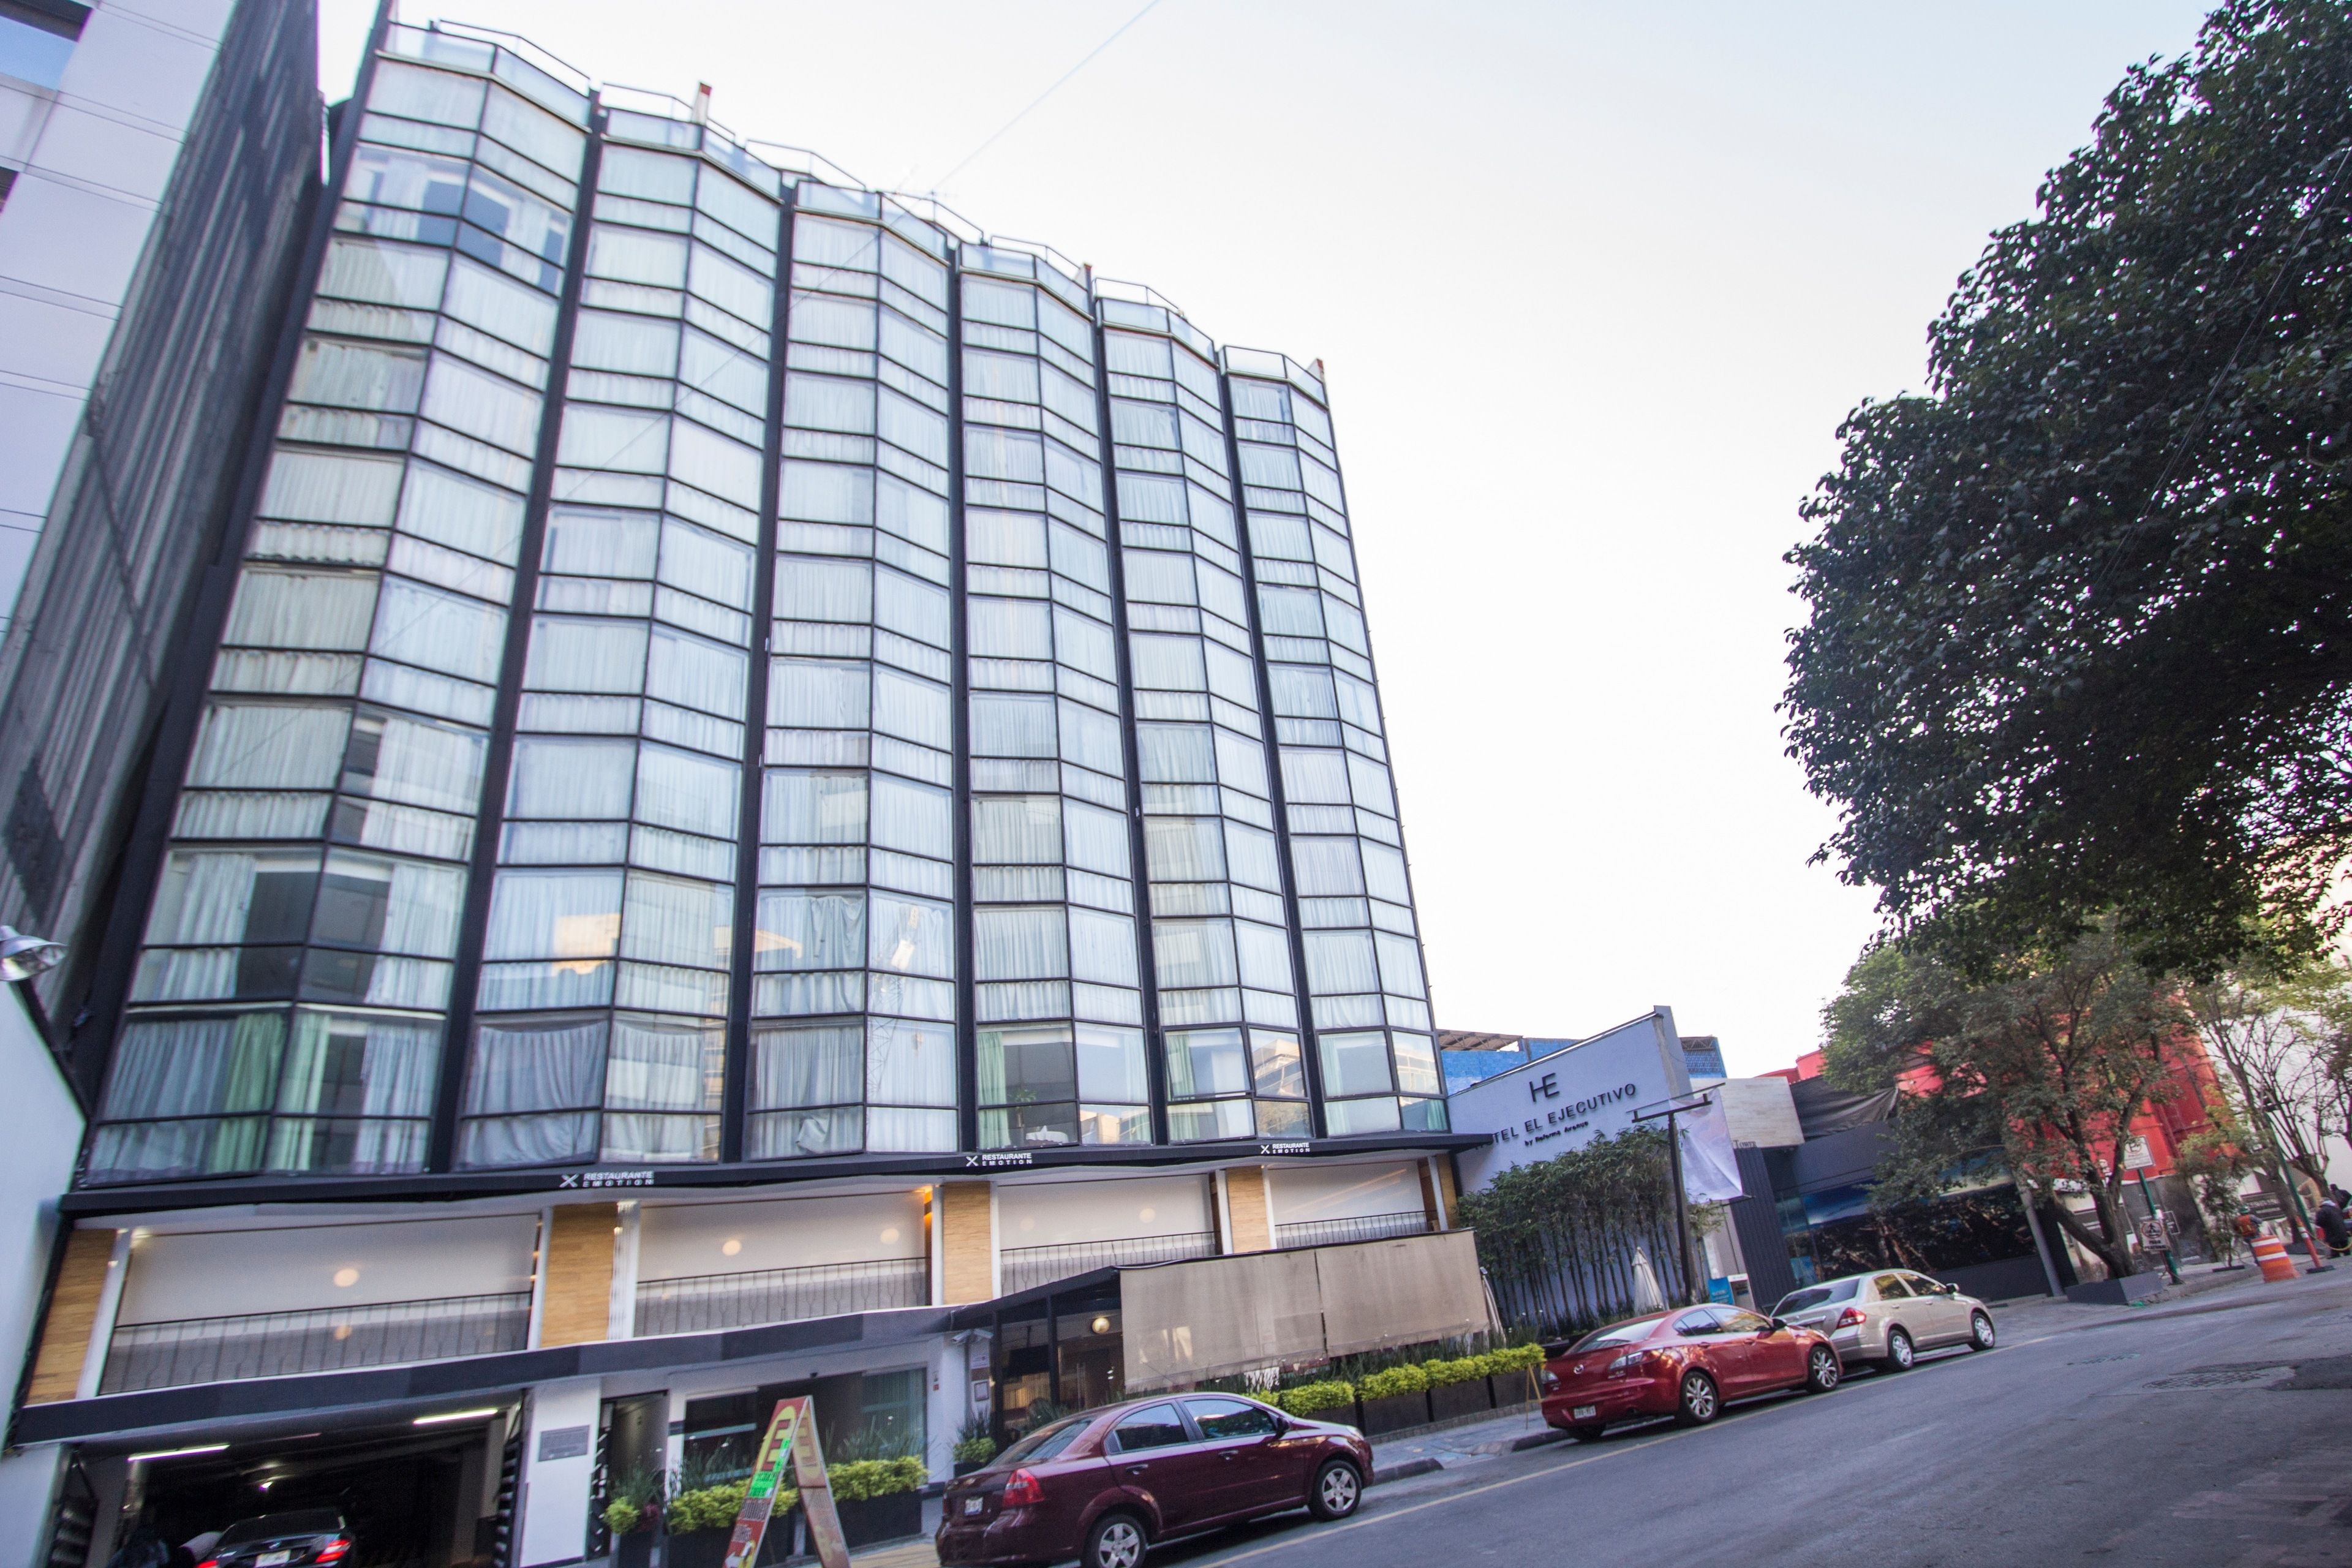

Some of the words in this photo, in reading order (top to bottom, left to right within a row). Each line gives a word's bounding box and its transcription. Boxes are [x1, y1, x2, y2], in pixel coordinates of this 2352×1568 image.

[1525, 1118, 1543, 1133] EL
[1548, 1083, 1637, 1125] EJECUTIVO
[1564, 1121, 1589, 1133] Avenue
[583, 1170, 654, 1181] RESTAURANTE
